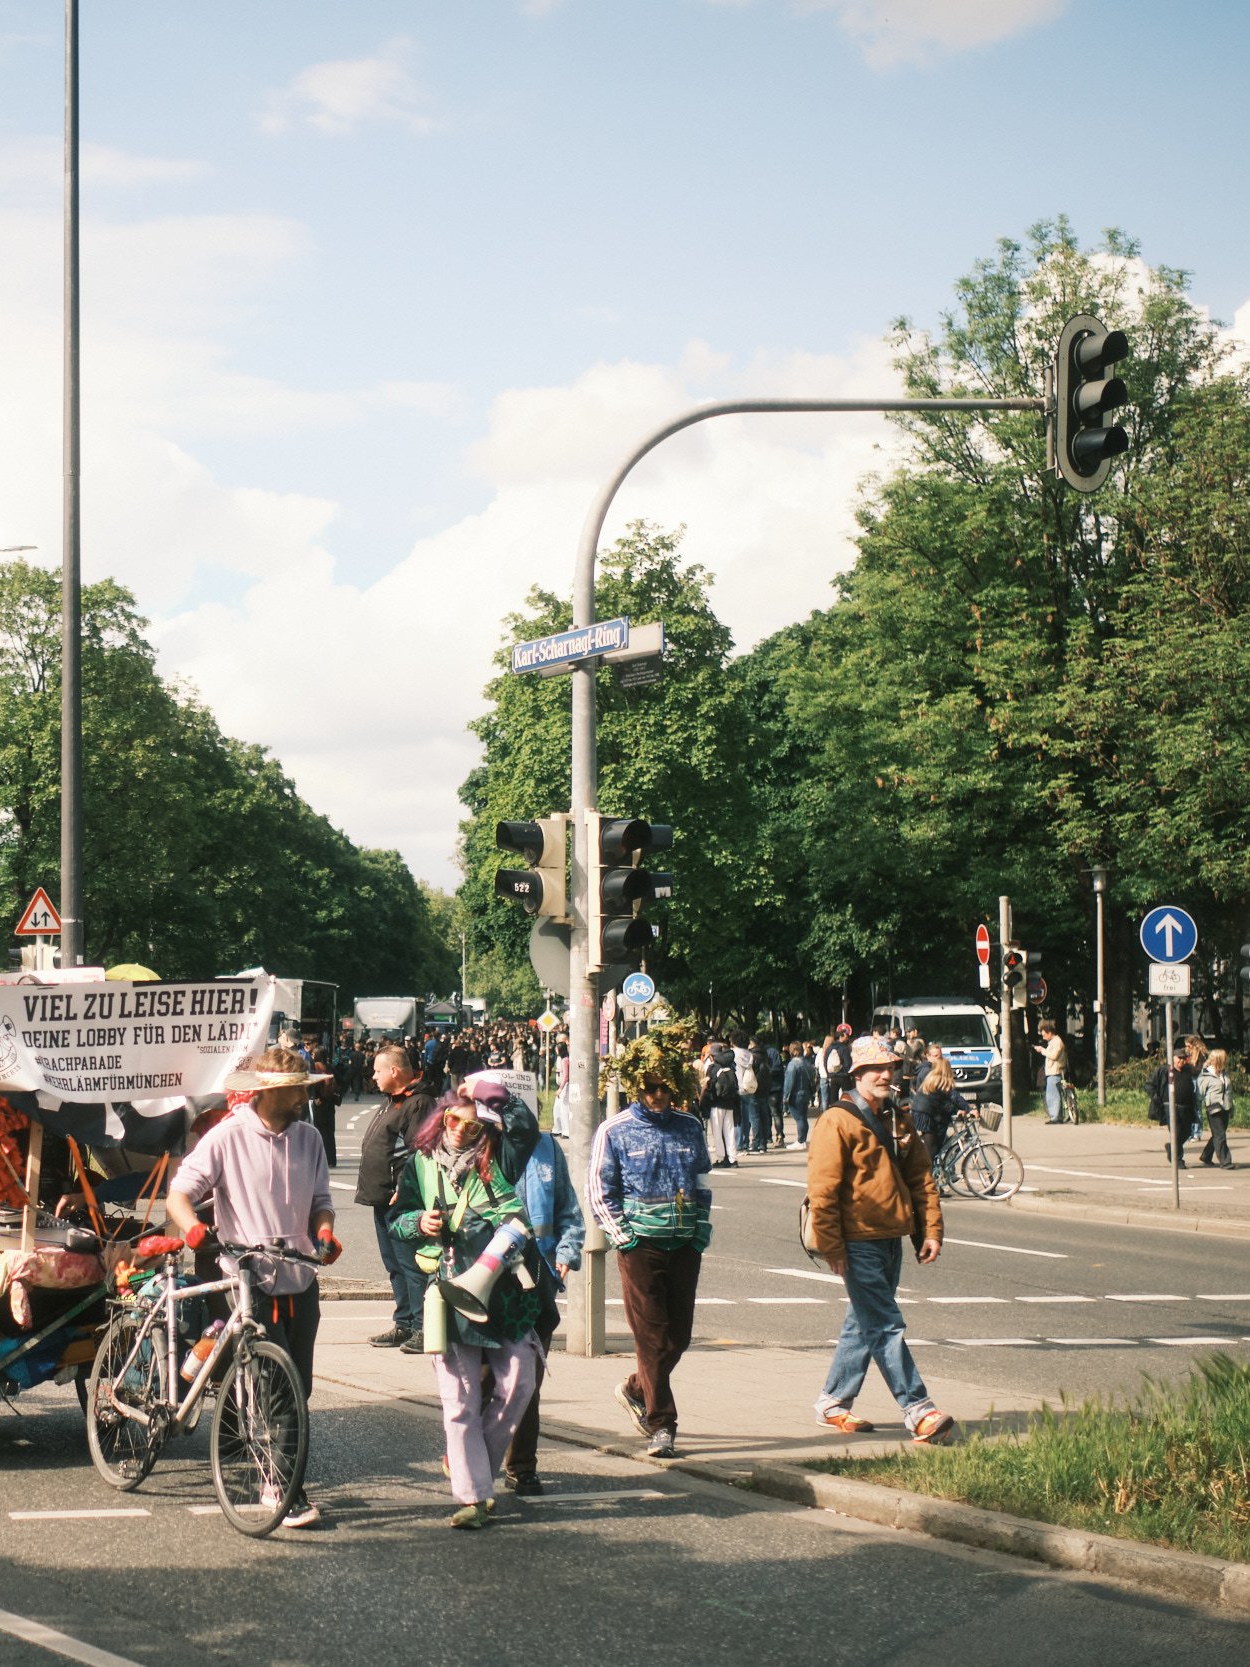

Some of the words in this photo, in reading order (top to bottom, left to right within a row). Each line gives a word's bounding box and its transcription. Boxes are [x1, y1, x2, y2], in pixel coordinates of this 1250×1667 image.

[514, 626, 621, 668] Karl-Scharnagl-Ring
[514, 882, 530, 893] 522
[23, 994, 77, 1022] VIEL
[83, 993, 114, 1020] ZU
[119, 990, 186, 1018] LEISE
[190, 988, 259, 1015] HIER!
[22, 1030, 70, 1048] DEINE
[77, 1027, 126, 1047] LOBBY
[134, 1023, 165, 1044] FÜR
[172, 1024, 202, 1043] DEN
[502, 1081, 535, 1091] ASCHEN-
[516, 1073, 531, 1082] UND
